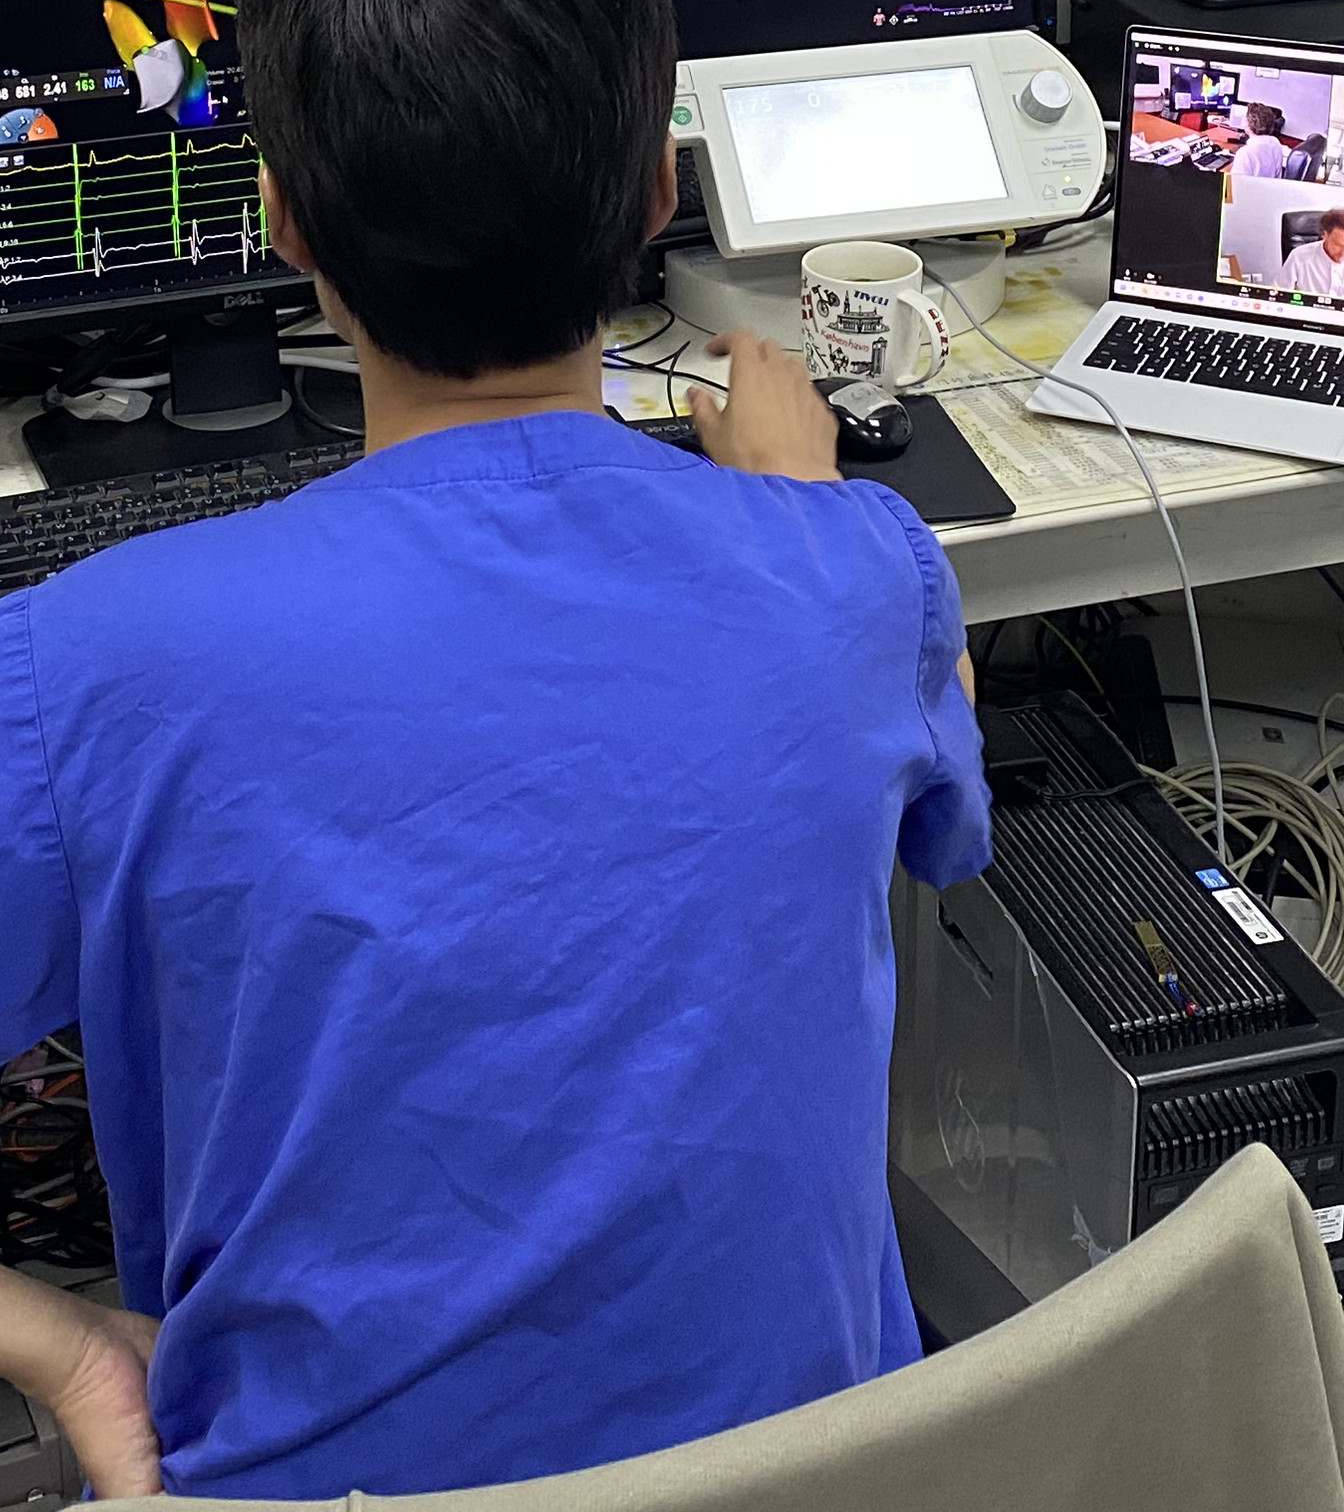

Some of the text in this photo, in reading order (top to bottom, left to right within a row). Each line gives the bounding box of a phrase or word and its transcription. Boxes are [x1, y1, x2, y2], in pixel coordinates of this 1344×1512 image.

[75, 79, 96, 92] 163
[103, 76, 125, 89] N/A
[808, 92, 821, 108] 0
[224, 292, 264, 308] DELL
[854, 289, 889, 307] TIVOLI
